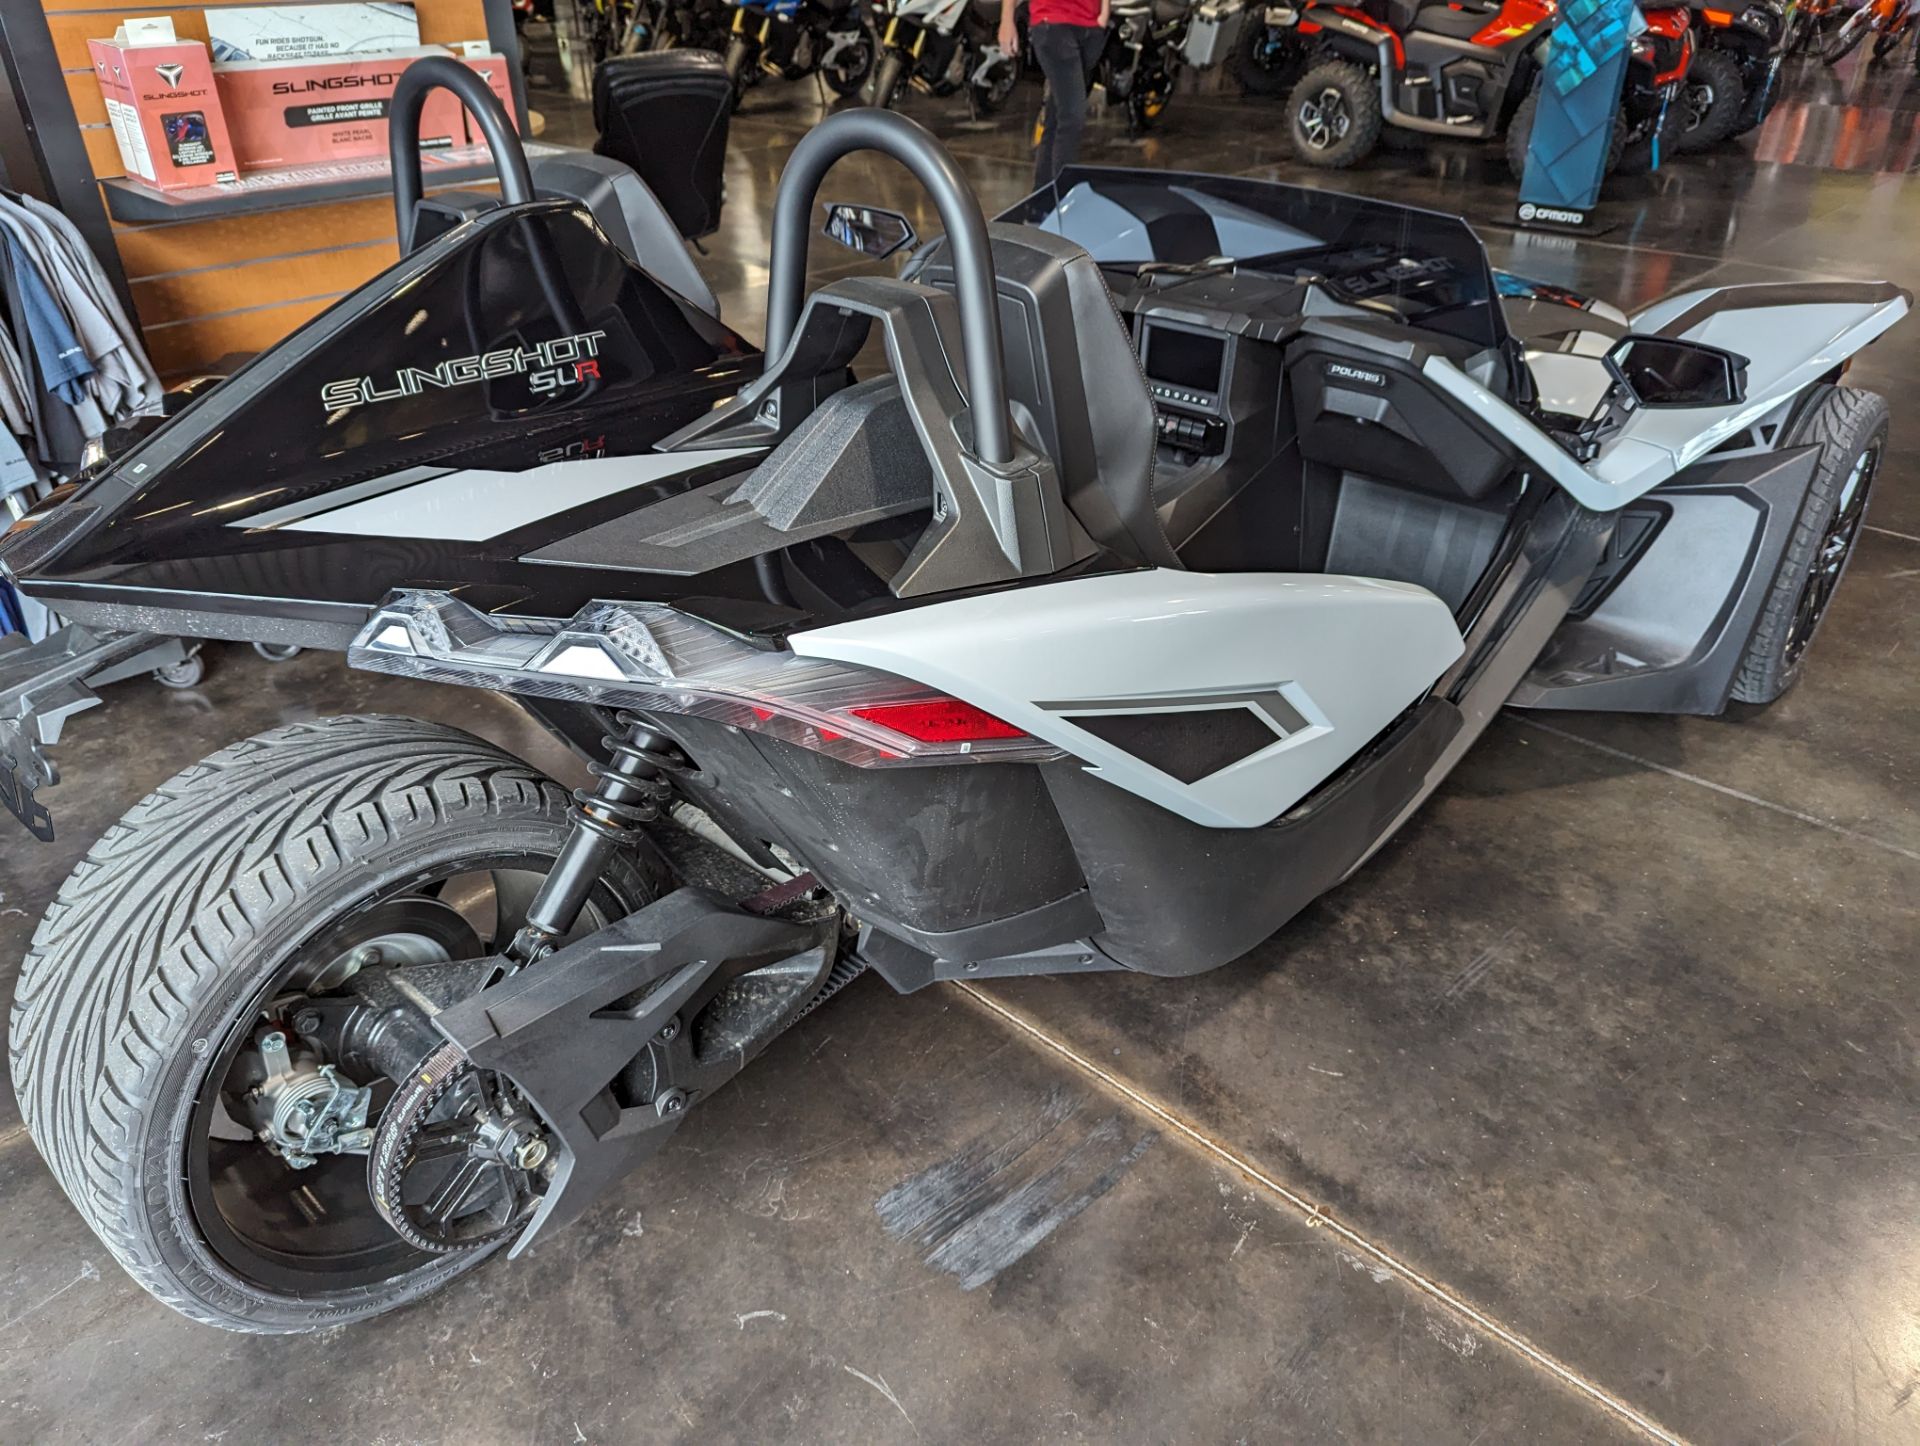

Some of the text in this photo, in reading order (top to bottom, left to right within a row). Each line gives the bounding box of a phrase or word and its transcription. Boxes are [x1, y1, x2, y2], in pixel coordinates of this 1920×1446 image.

[255, 38, 269, 46] FUN
[270, 37, 290, 45] RIDES
[276, 44, 307, 52] BECAUSE
[315, 42, 329, 50] HAS
[272, 72, 400, 95] SLINGSHO
[143, 89, 208, 101] SLINGSHOT
[306, 101, 383, 115] PAINTED FRONT GRILLE
[310, 109, 382, 122] GRILLE AVANT PEINTE
[1536, 208, 1584, 224] CFMOTO
[321, 330, 606, 412] SLINGSHOT
[529, 359, 601, 394] SLR
[1330, 364, 1380, 383] POLARIS
